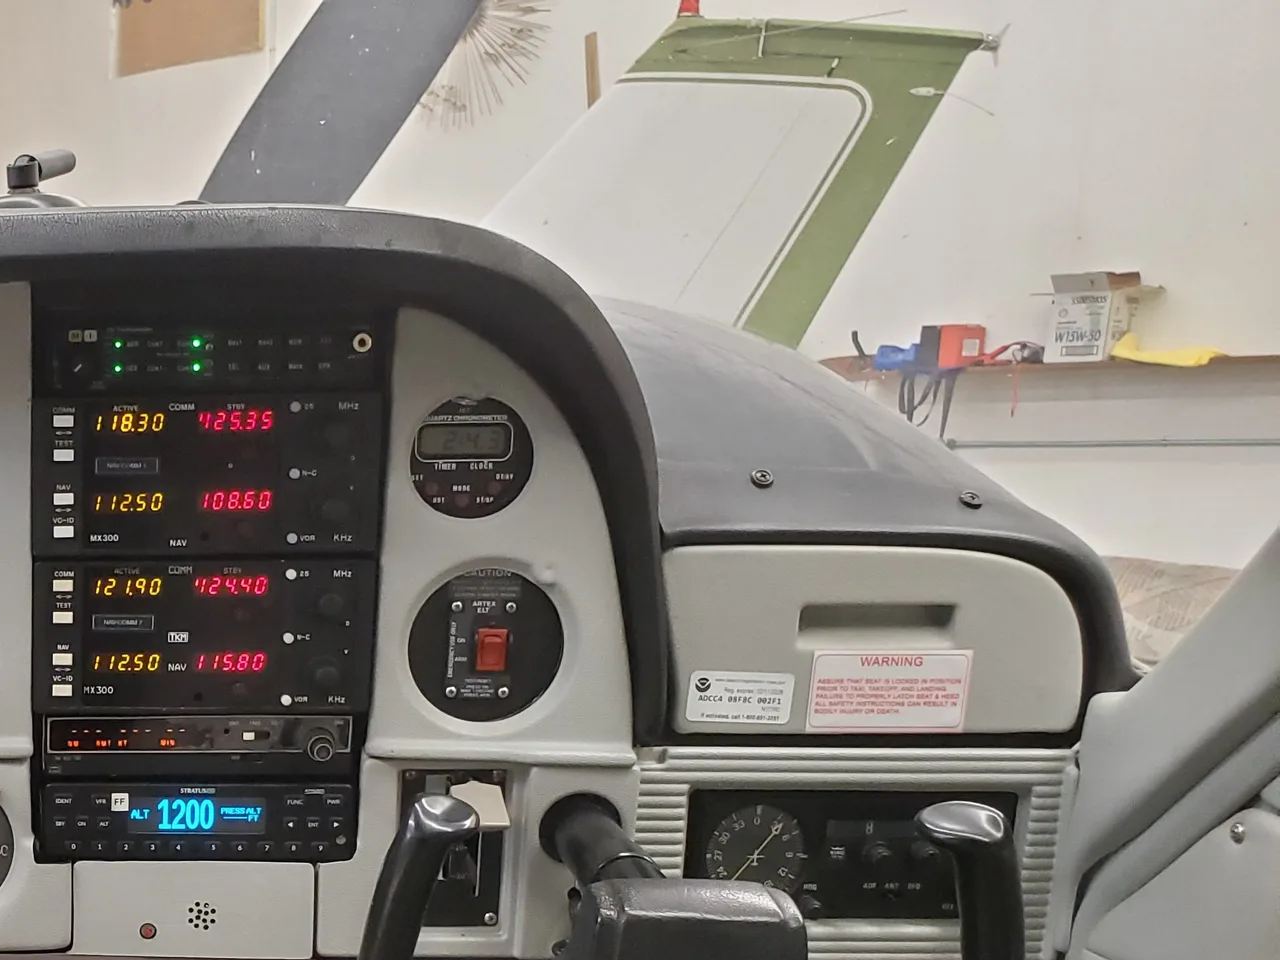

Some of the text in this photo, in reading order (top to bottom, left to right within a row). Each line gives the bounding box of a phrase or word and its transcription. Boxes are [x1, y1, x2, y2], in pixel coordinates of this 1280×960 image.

[112, 404, 139, 412] ACTIVE
[168, 402, 196, 411] COMM
[338, 402, 359, 410] MHz
[96, 413, 164, 432] 118.30
[470, 462, 494, 470] CLOCK
[95, 493, 163, 512] 112.50
[89, 534, 119, 542] MX300
[299, 534, 316, 542] VOR
[333, 533, 353, 542] KHz
[169, 539, 188, 547] NAV
[168, 565, 193, 574] COMM
[333, 569, 352, 578] MHz
[95, 578, 162, 596] 121.90
[169, 632, 188, 642] TKM
[94, 654, 160, 671] 112.50
[860, 656, 924, 667] WARNING
[167, 663, 187, 672] NAV
[83, 686, 114, 694] MX300
[328, 695, 346, 704] KHz
[698, 694, 782, 705] ADCC4 08F8C 002F1
[114, 797, 126, 806] FF
[130, 808, 150, 820] ALT
[157, 798, 215, 830] 1200
[220, 807, 262, 815] PRESS ALT
